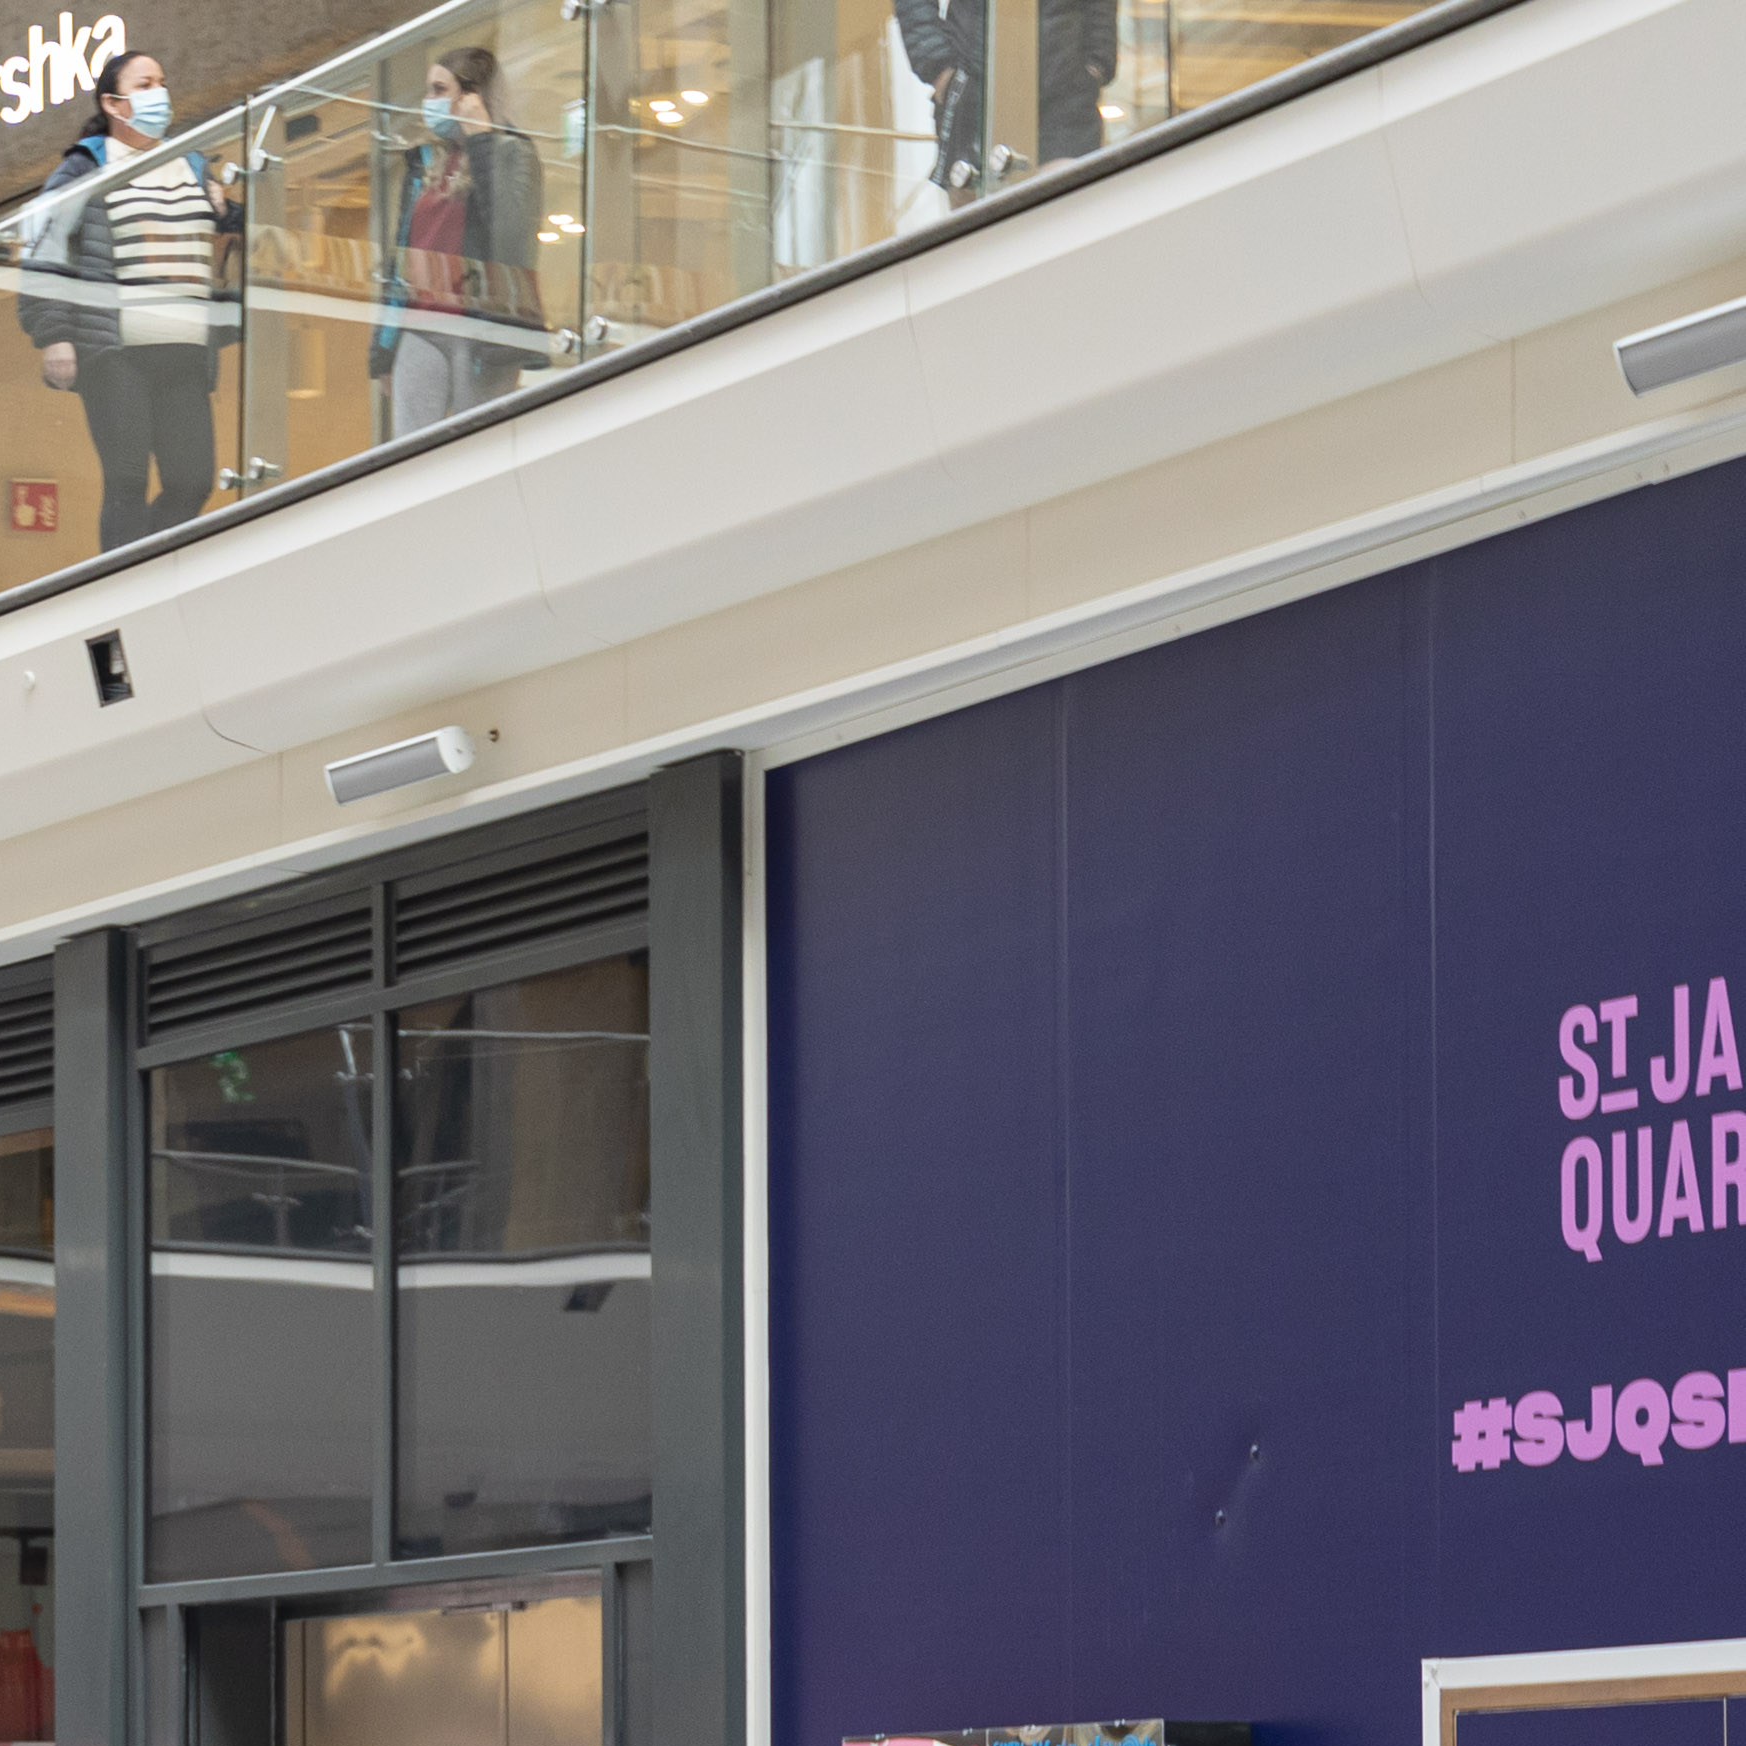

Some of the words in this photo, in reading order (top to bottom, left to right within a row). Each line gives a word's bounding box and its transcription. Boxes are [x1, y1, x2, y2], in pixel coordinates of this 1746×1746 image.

[1558, 994, 1639, 1121] ST
[1650, 976, 1745, 1105] JA
[1560, 1110, 1746, 1263] QUAR
